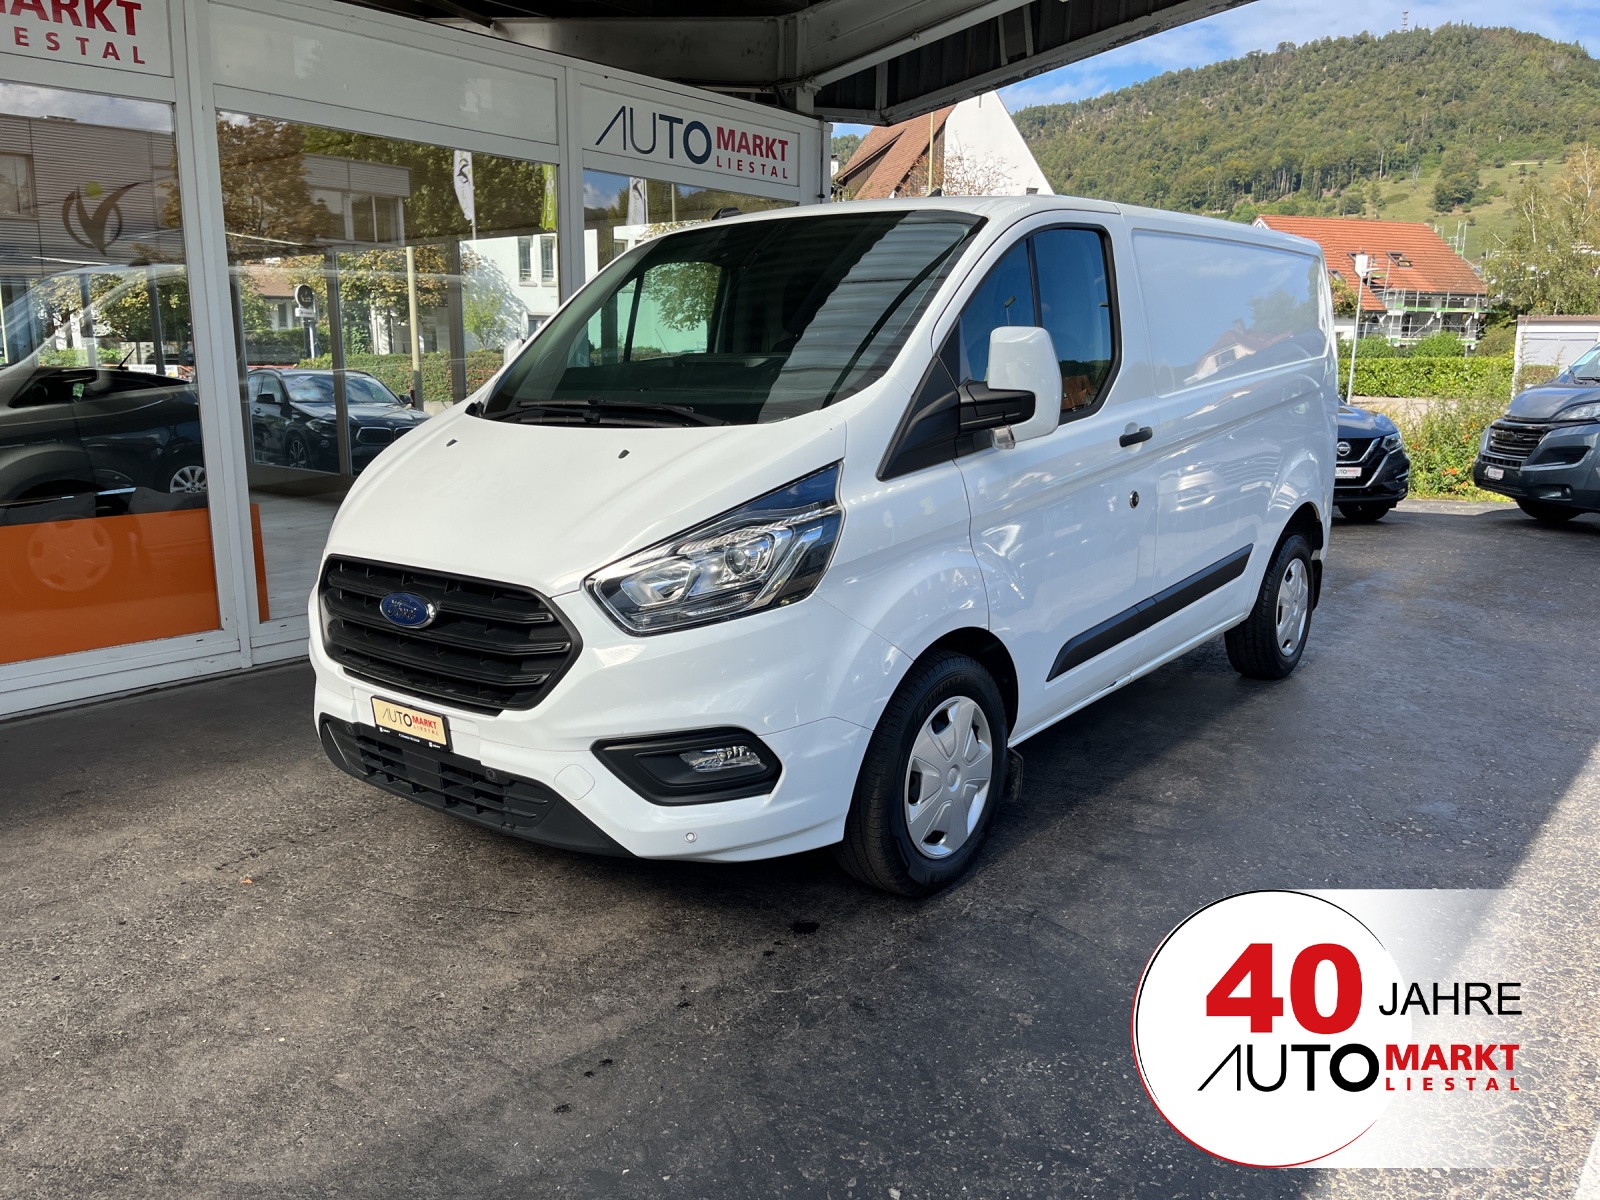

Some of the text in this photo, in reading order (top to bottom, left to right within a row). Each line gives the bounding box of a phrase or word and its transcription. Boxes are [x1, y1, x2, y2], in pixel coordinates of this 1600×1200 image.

[0, 0, 142, 36] ARKT
[716, 126, 789, 162] MARKT
[716, 155, 788, 180] LIESTAL
[412, 715, 437, 729] MARKT
